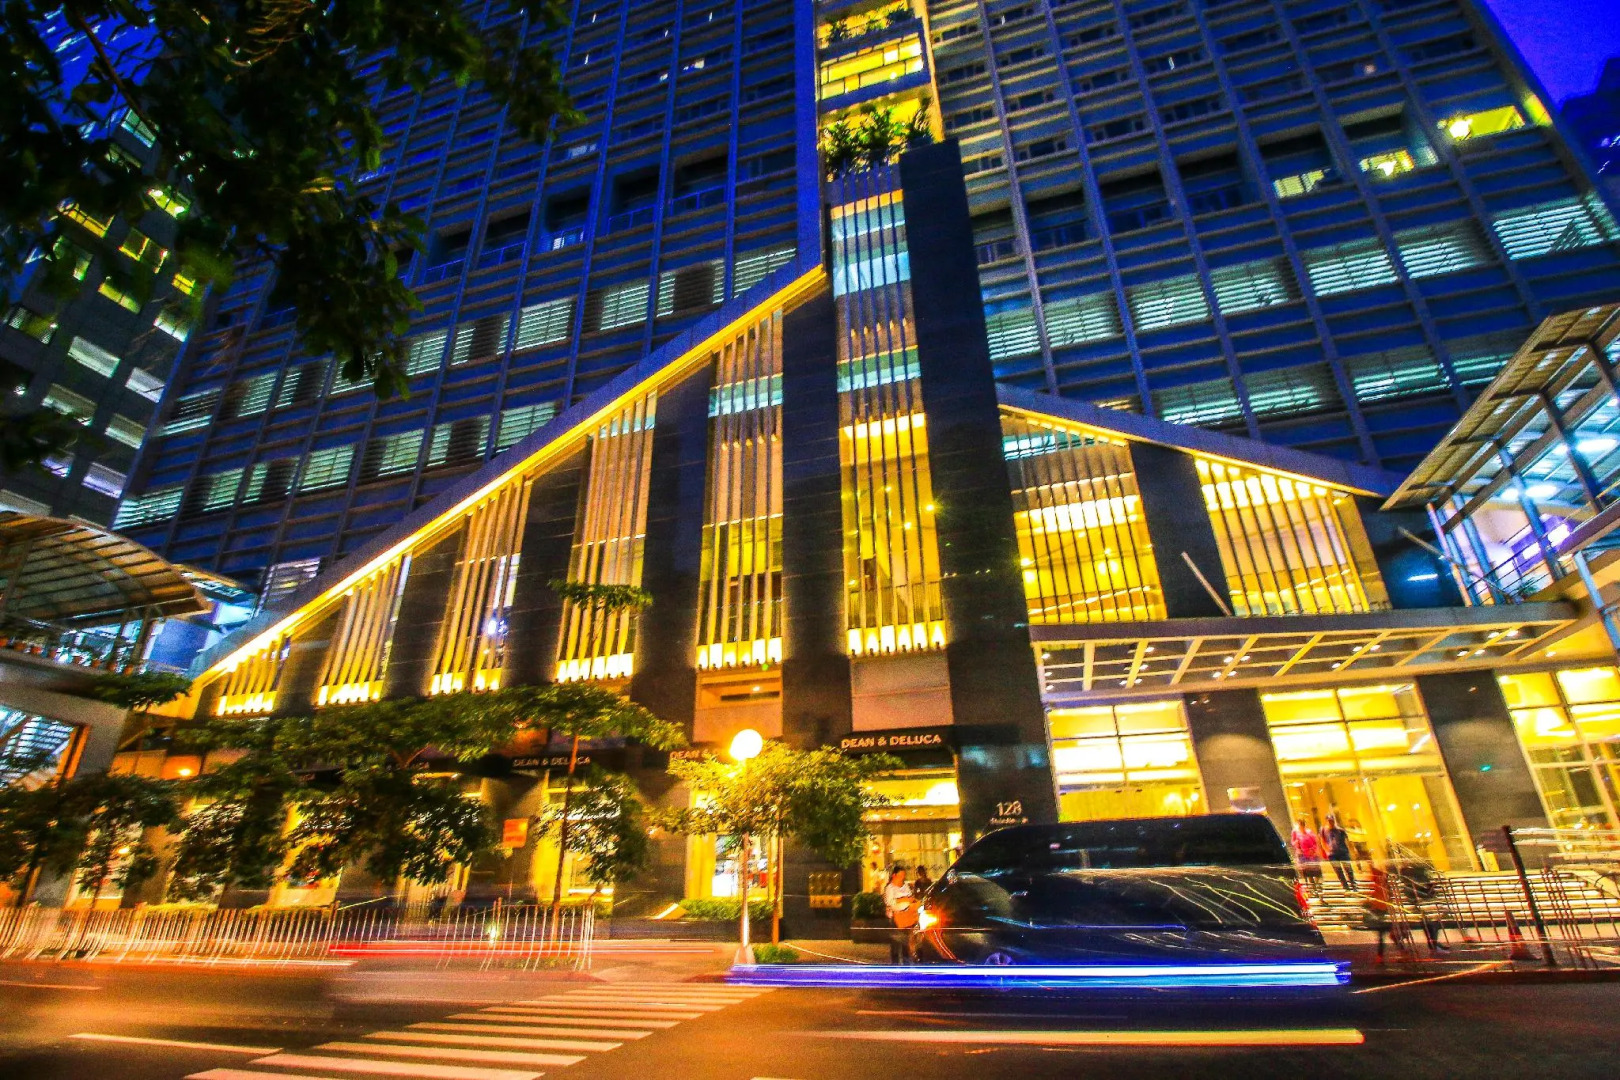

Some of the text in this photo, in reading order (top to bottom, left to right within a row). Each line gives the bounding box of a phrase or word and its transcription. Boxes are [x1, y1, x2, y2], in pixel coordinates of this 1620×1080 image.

[841, 734, 942, 749] DEAN & DELUCA
[669, 750, 700, 760] DEAN
[551, 756, 591, 766] DELCA
